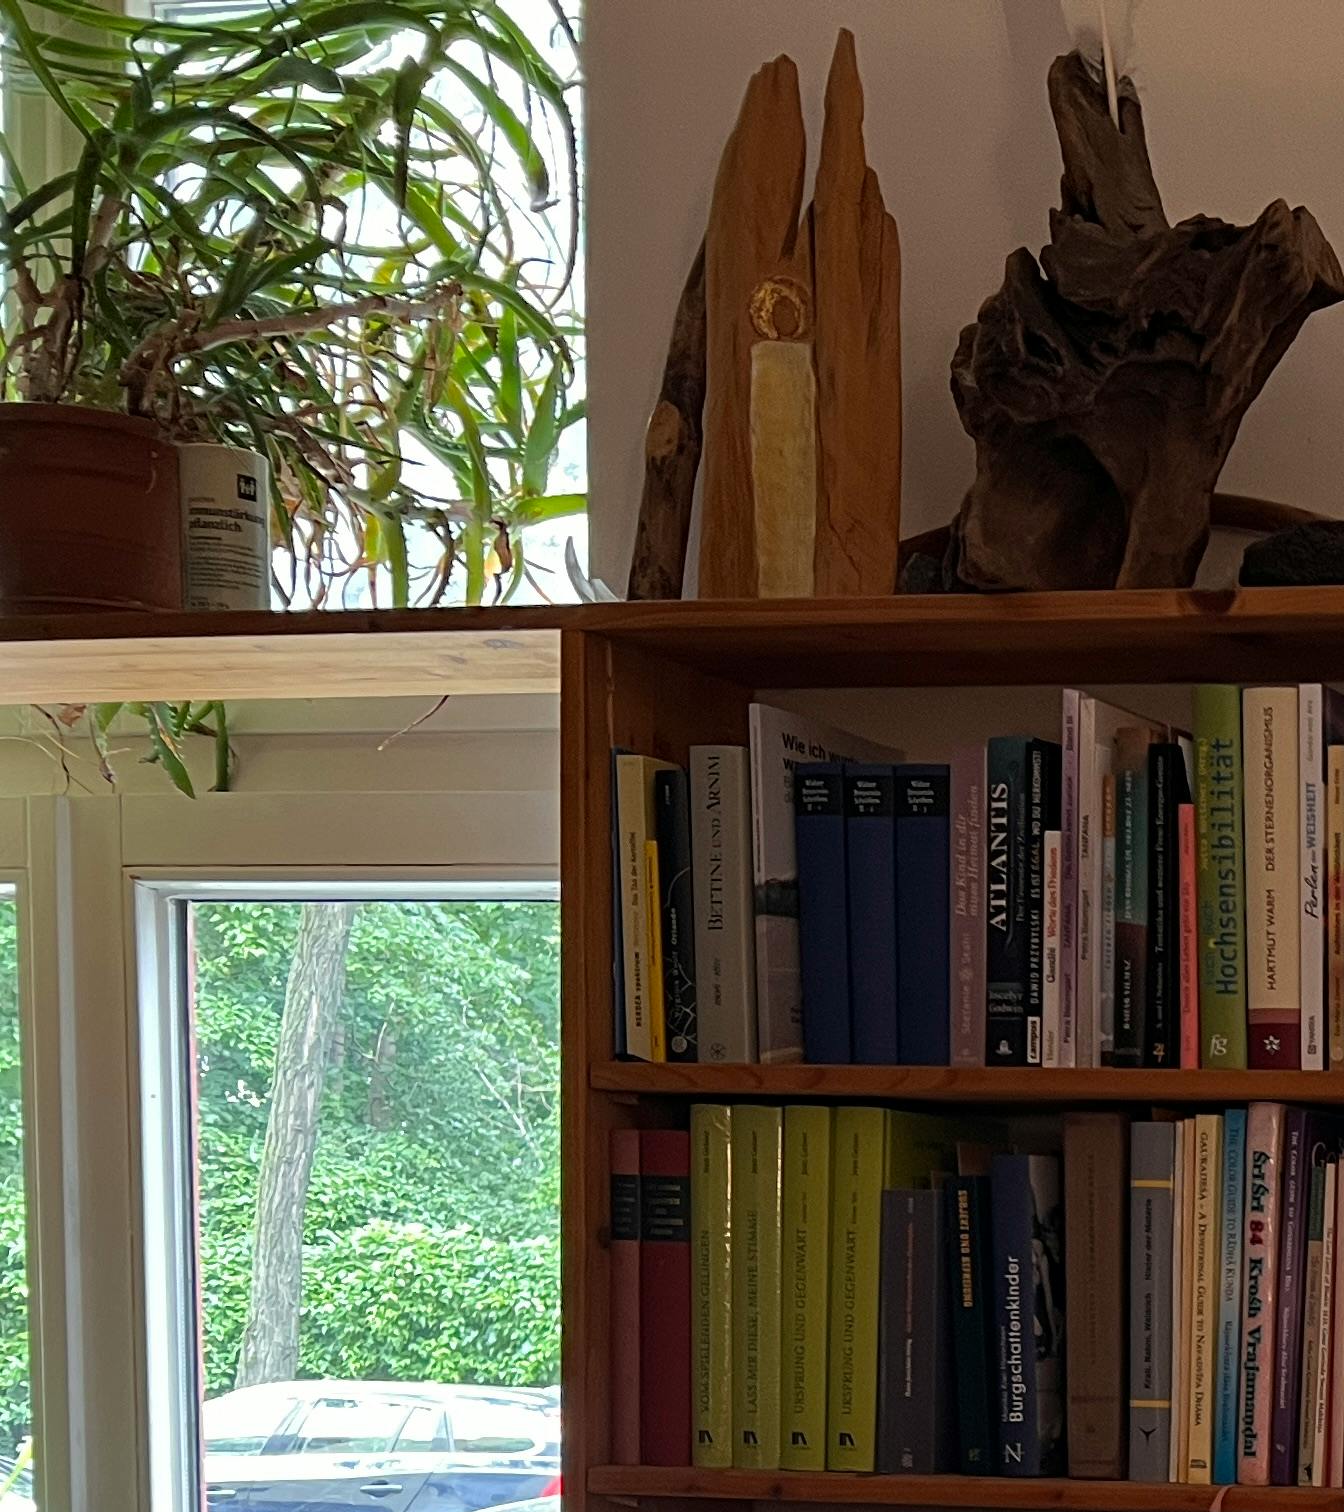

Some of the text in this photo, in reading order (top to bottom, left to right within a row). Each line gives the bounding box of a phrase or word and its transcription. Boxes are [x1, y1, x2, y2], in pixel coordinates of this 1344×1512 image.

[783, 733, 825, 760] Wie ich
[706, 755, 721, 814] ARNIM
[1032, 806, 1041, 819] DU
[954, 814, 967, 915] Das Kind in dir
[990, 783, 1008, 932] ATLANTIS
[1210, 737, 1239, 995] Hochsensibilität
[1264, 707, 1276, 990] HARTMUT WARM DER STERNENORGANISMUS
[1304, 782, 1320, 919] Perlen WEISHEIT
[707, 852, 724, 930] BETTINE
[670, 907, 678, 945] Orlando
[1047, 910, 1057, 937] Worte
[1046, 947, 1057, 983] Gandhi
[1064, 1020, 1072, 1044] Petra
[700, 1230, 710, 1295] GELINGEN
[1250, 1220, 1264, 1246] 84
[748, 1264, 757, 1307] MEINE
[794, 1228, 807, 1414] URSPRUNG UND GEGENWART
[841, 1228, 857, 1415] URSPRUNG UND GEGENWART
[1006, 1255, 1026, 1422] Burgschattenkinder
[748, 1384, 758, 1414] LASS
